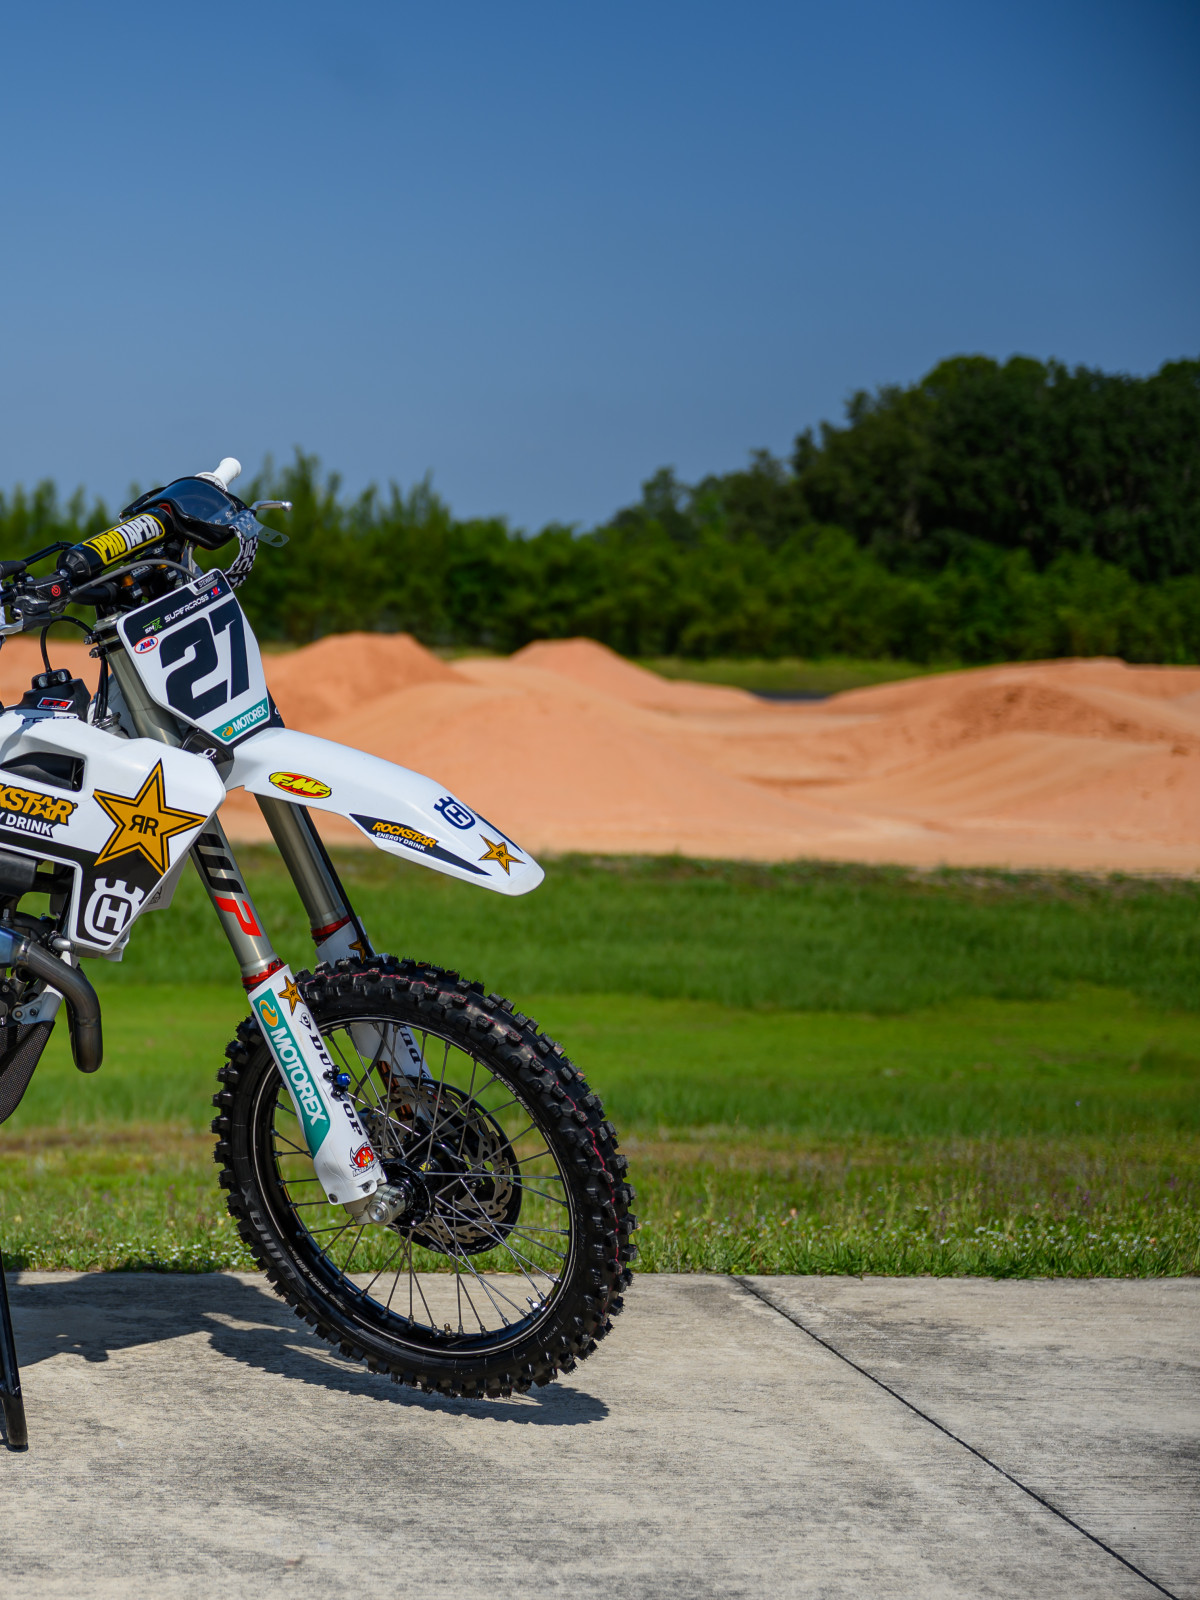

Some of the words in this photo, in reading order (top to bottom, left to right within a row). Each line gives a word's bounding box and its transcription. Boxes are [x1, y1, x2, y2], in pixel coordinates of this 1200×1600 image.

[90, 514, 161, 559] PROTAPER
[164, 593, 210, 623] SUPERCROSS
[159, 597, 250, 721] 27
[232, 703, 268, 732] MOTOREX
[269, 772, 332, 798] FMF
[5, 813, 53, 836] DRINK
[371, 821, 437, 848] ROCKSTAR
[375, 831, 404, 844] ENERGY
[403, 838, 426, 852] DRINK
[270, 1027, 327, 1127] MOTOREX
